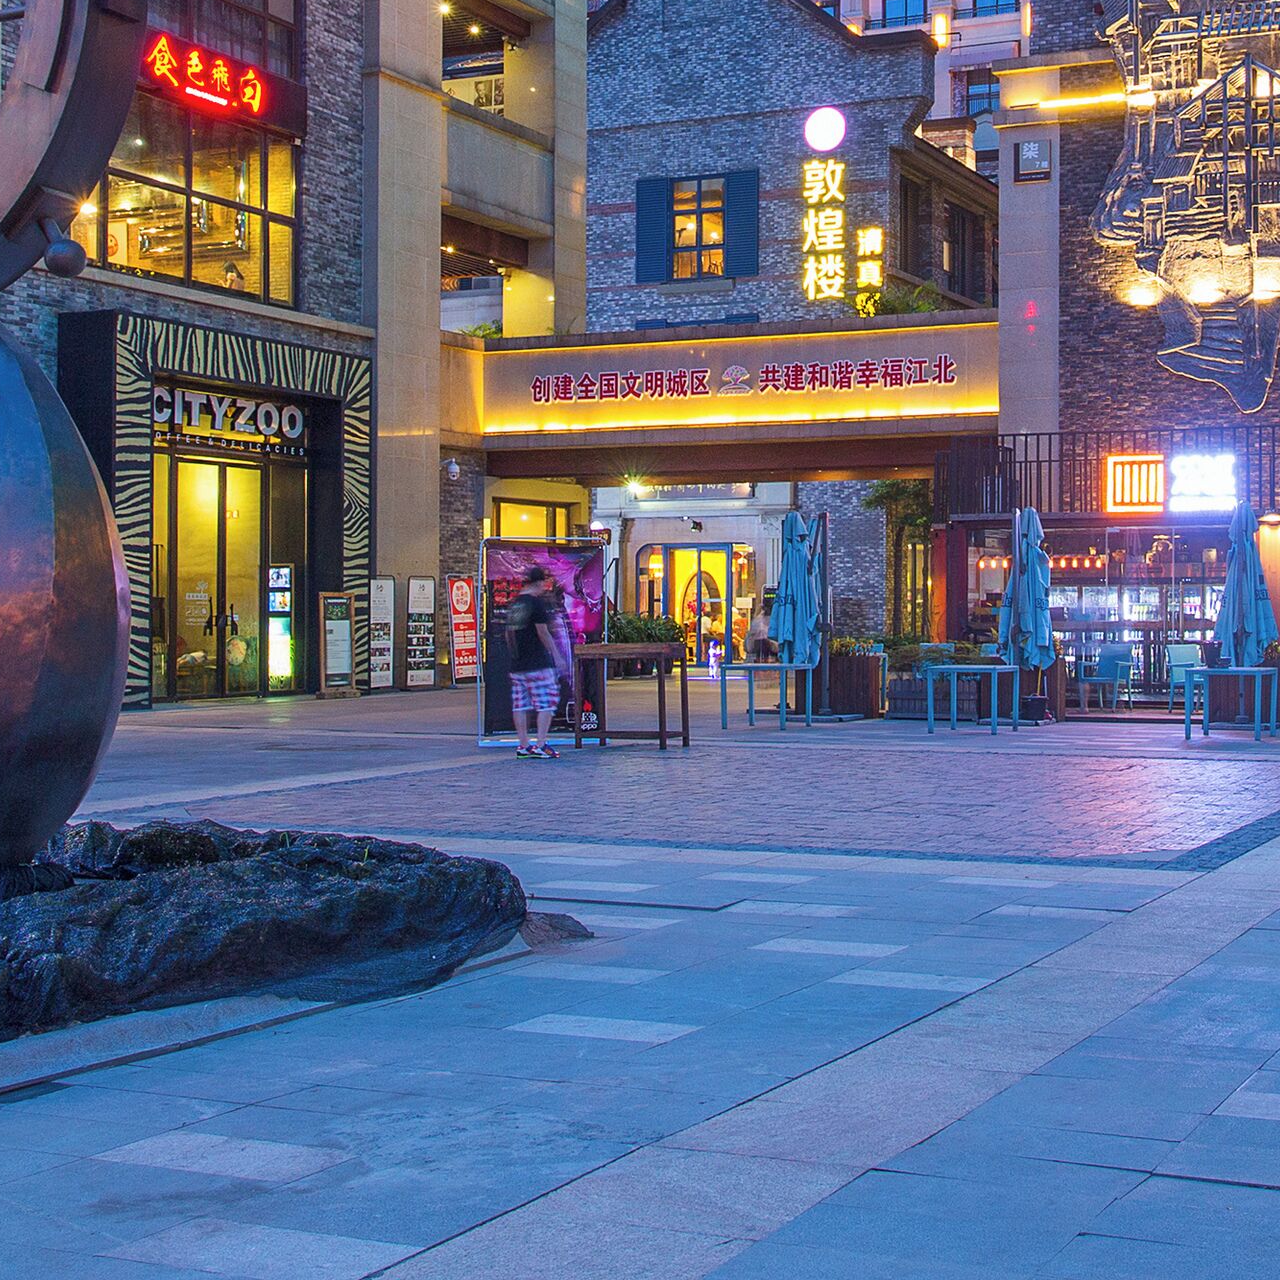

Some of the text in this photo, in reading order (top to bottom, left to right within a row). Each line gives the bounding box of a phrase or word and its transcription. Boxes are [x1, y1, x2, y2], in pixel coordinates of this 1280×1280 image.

[1022, 142, 1039, 159] 柒
[803, 159, 845, 301] 敦煌楼
[856, 227, 883, 289] 清真
[531, 353, 958, 404] 创建全国文明城区 共建和谐幸福江北
[155, 432, 200, 445] OFFEE
[221, 439, 304, 456] DELICACIES
